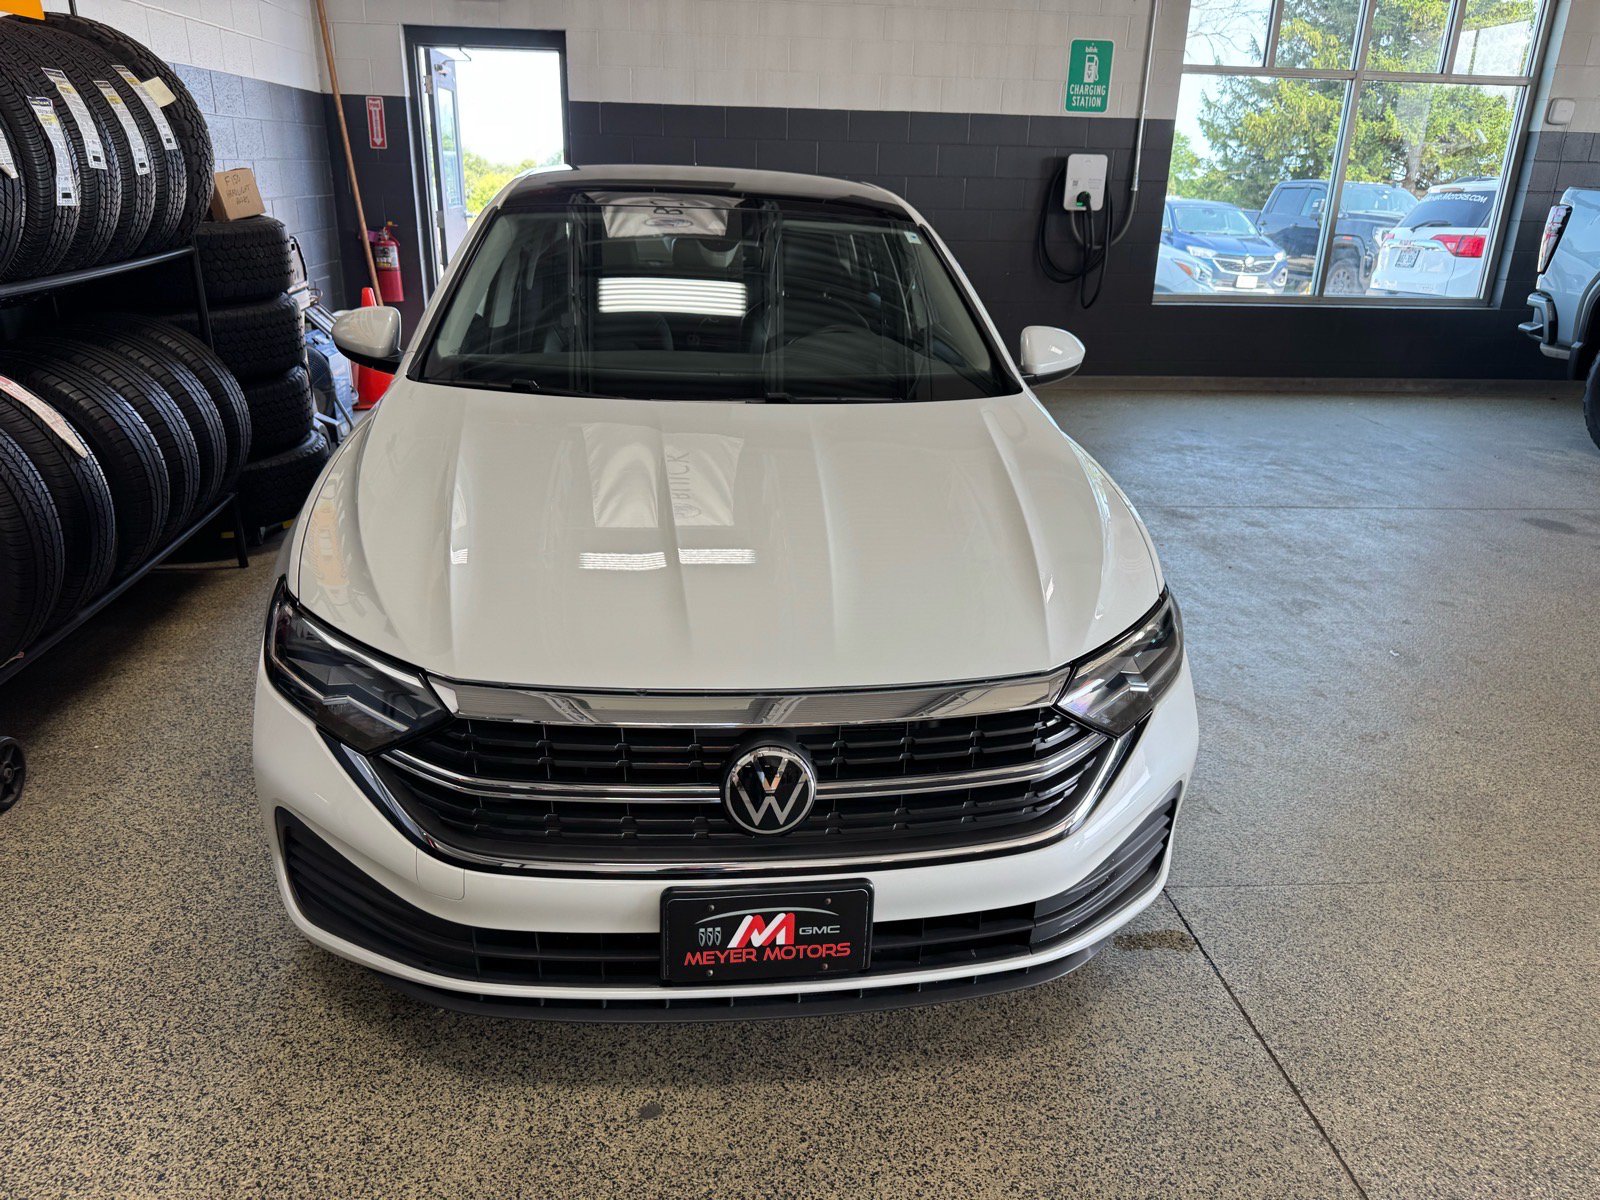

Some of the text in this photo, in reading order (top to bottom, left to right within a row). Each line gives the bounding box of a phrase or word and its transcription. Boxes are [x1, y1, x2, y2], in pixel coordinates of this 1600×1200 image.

[1070, 84, 1106, 95] CHARGING
[1072, 96, 1101, 108] STATION
[730, 754, 810, 827] VW
[799, 925, 841, 935] GMC
[684, 942, 851, 966] MEYER MOTORS
